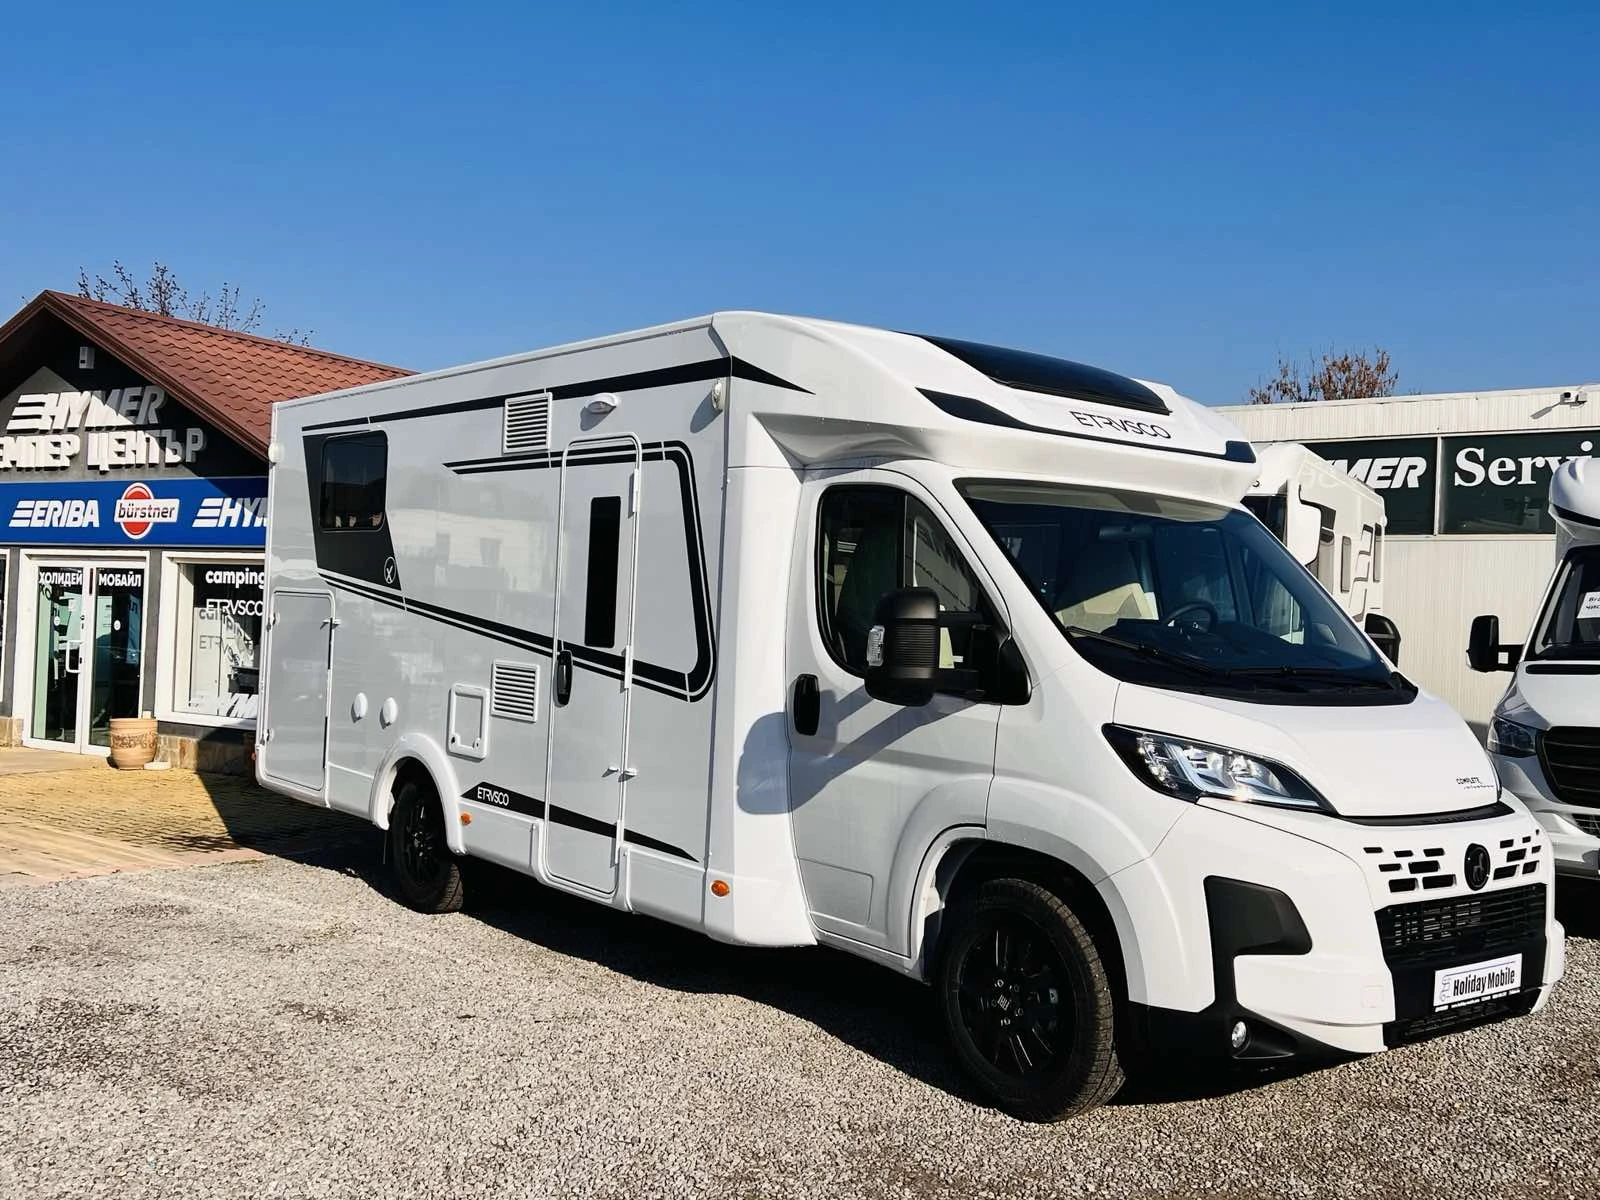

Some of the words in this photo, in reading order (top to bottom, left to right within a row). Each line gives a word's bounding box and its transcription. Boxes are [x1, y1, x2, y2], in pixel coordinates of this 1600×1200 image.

[38, 385, 165, 430] HYMER
[0, 434, 80, 468] МПЕР
[87, 427, 204, 471] ЦЕНТЪР
[1326, 457, 1427, 489] MER
[30, 499, 100, 528] ERIBA
[117, 502, 176, 519] bürstner
[38, 570, 83, 587] ХОЛИДЕЙ
[98, 571, 142, 587] МОБАЙЛ
[205, 567, 265, 589] camping
[1453, 973, 1487, 997] Holiday
[1487, 967, 1515, 990] Mobile
